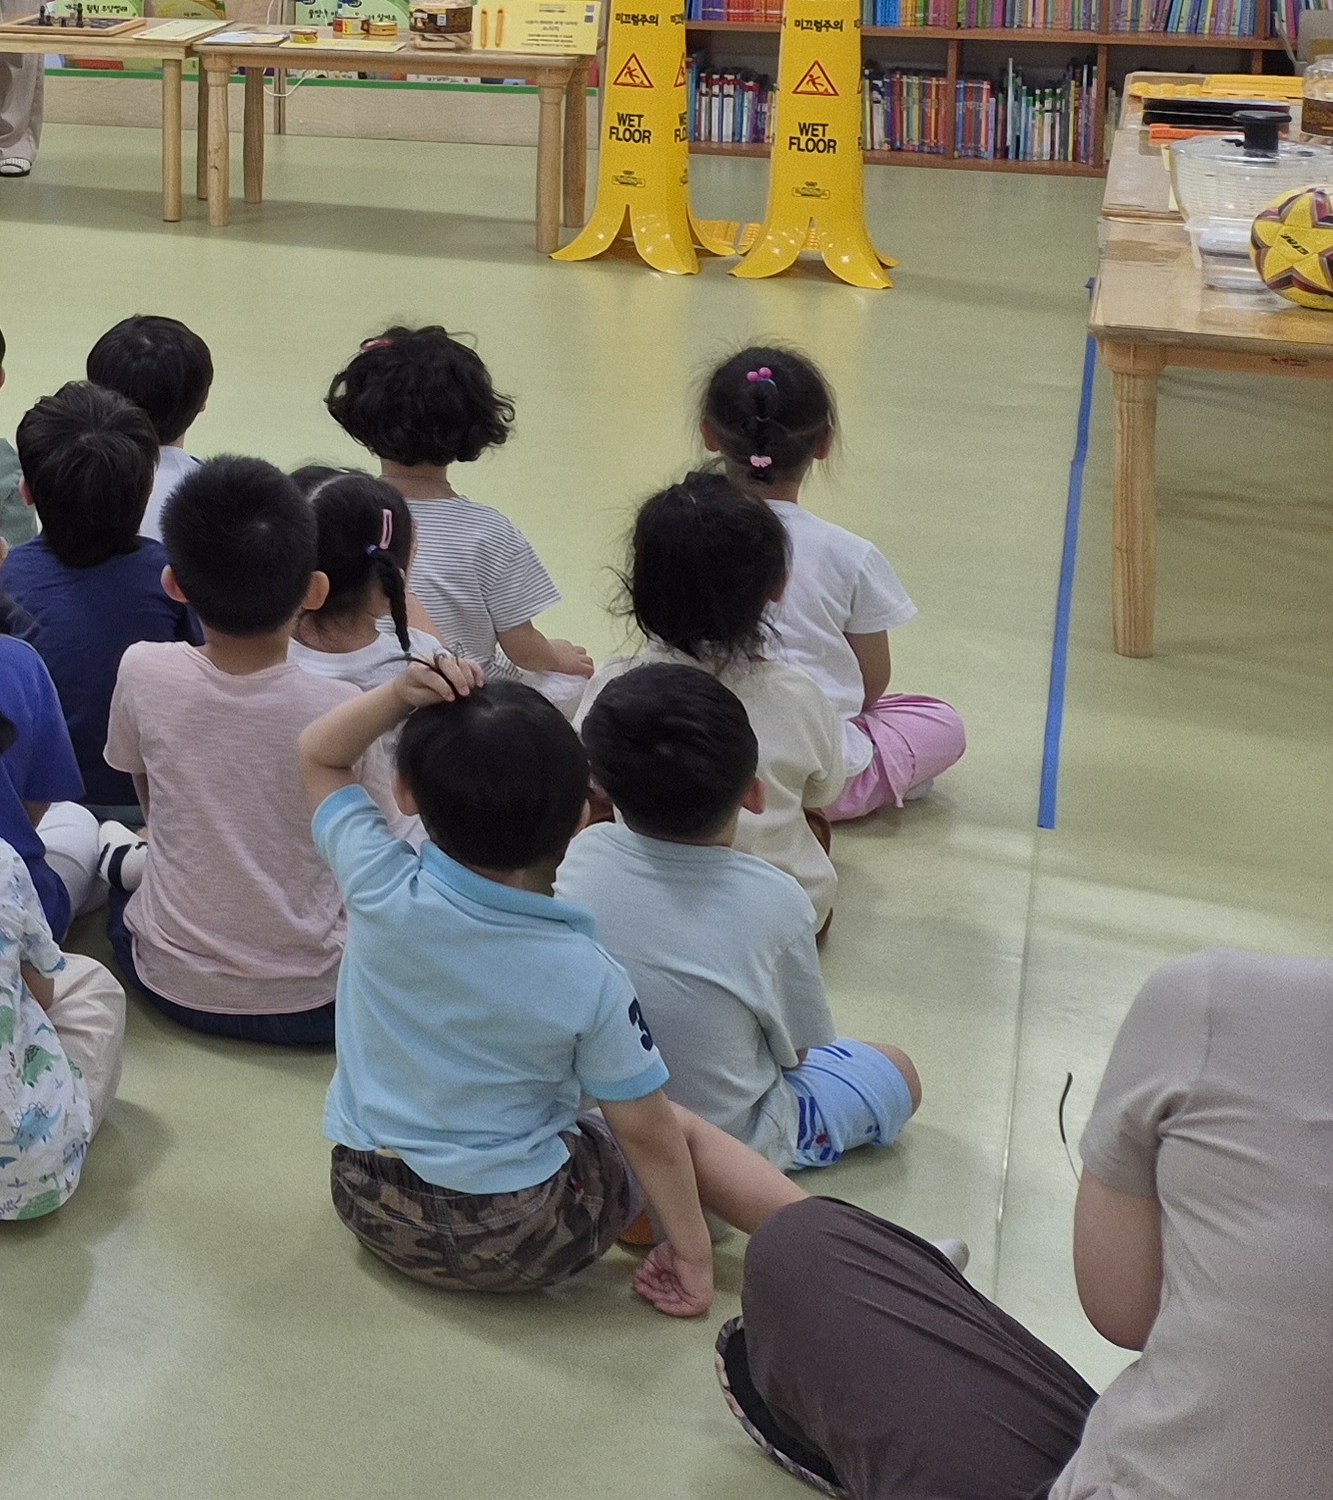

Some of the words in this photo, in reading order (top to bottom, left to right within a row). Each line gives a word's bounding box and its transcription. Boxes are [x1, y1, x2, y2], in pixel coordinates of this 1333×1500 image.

[615, 13, 659, 26] 미끄럼주의
[794, 19, 844, 32] 미끄럼주의
[616, 112, 644, 128] WET
[609, 126, 652, 144] FLOOR
[798, 122, 829, 138] WET
[789, 136, 837, 154] FLOOR
